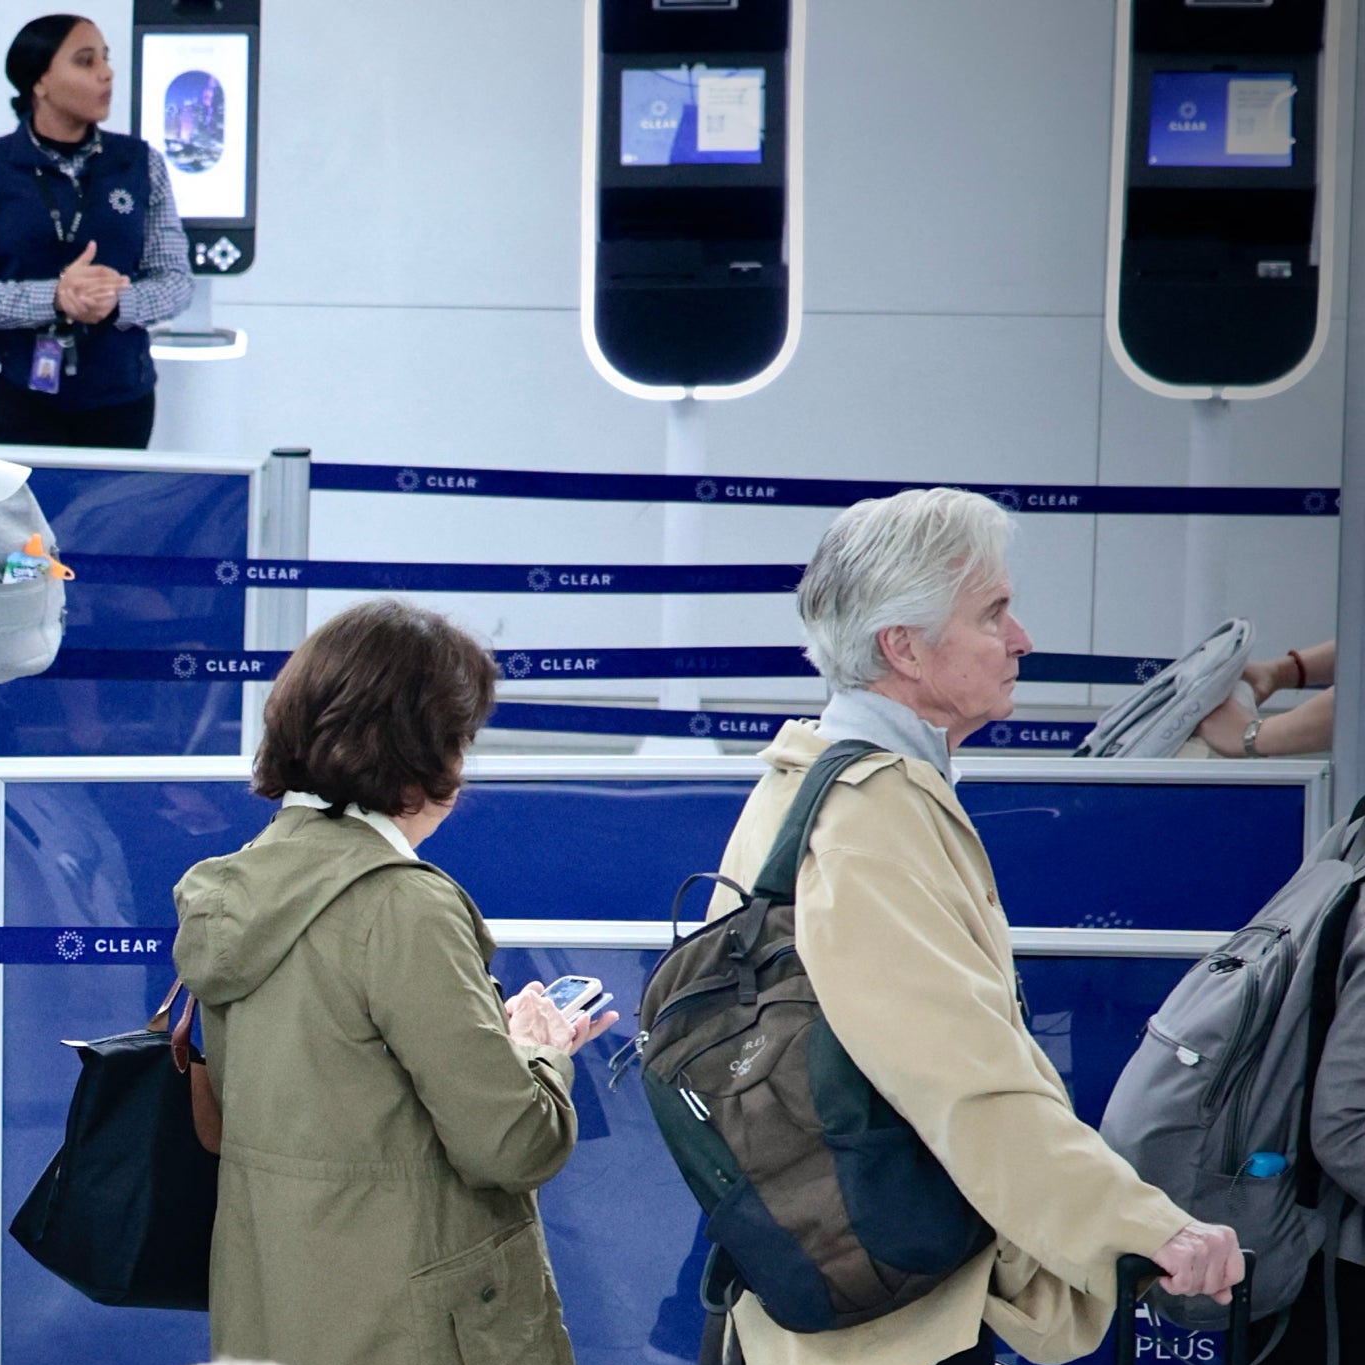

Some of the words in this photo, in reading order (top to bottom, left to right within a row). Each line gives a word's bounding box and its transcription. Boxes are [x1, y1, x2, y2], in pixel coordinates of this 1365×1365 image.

[426, 475, 476, 488] CLEAR
[725, 485, 776, 498] CLEAR
[1027, 494, 1079, 506] CLEAR
[246, 566, 300, 580] CLEAR
[559, 573, 611, 586] CLEAR
[205, 659, 262, 673] CLEAR
[540, 658, 598, 671] CLEAR
[719, 720, 770, 733] CLEAR
[1019, 729, 1071, 742] CLEAR
[94, 938, 157, 953] CLEAR
[1136, 1337, 1215, 1361] PLUS
